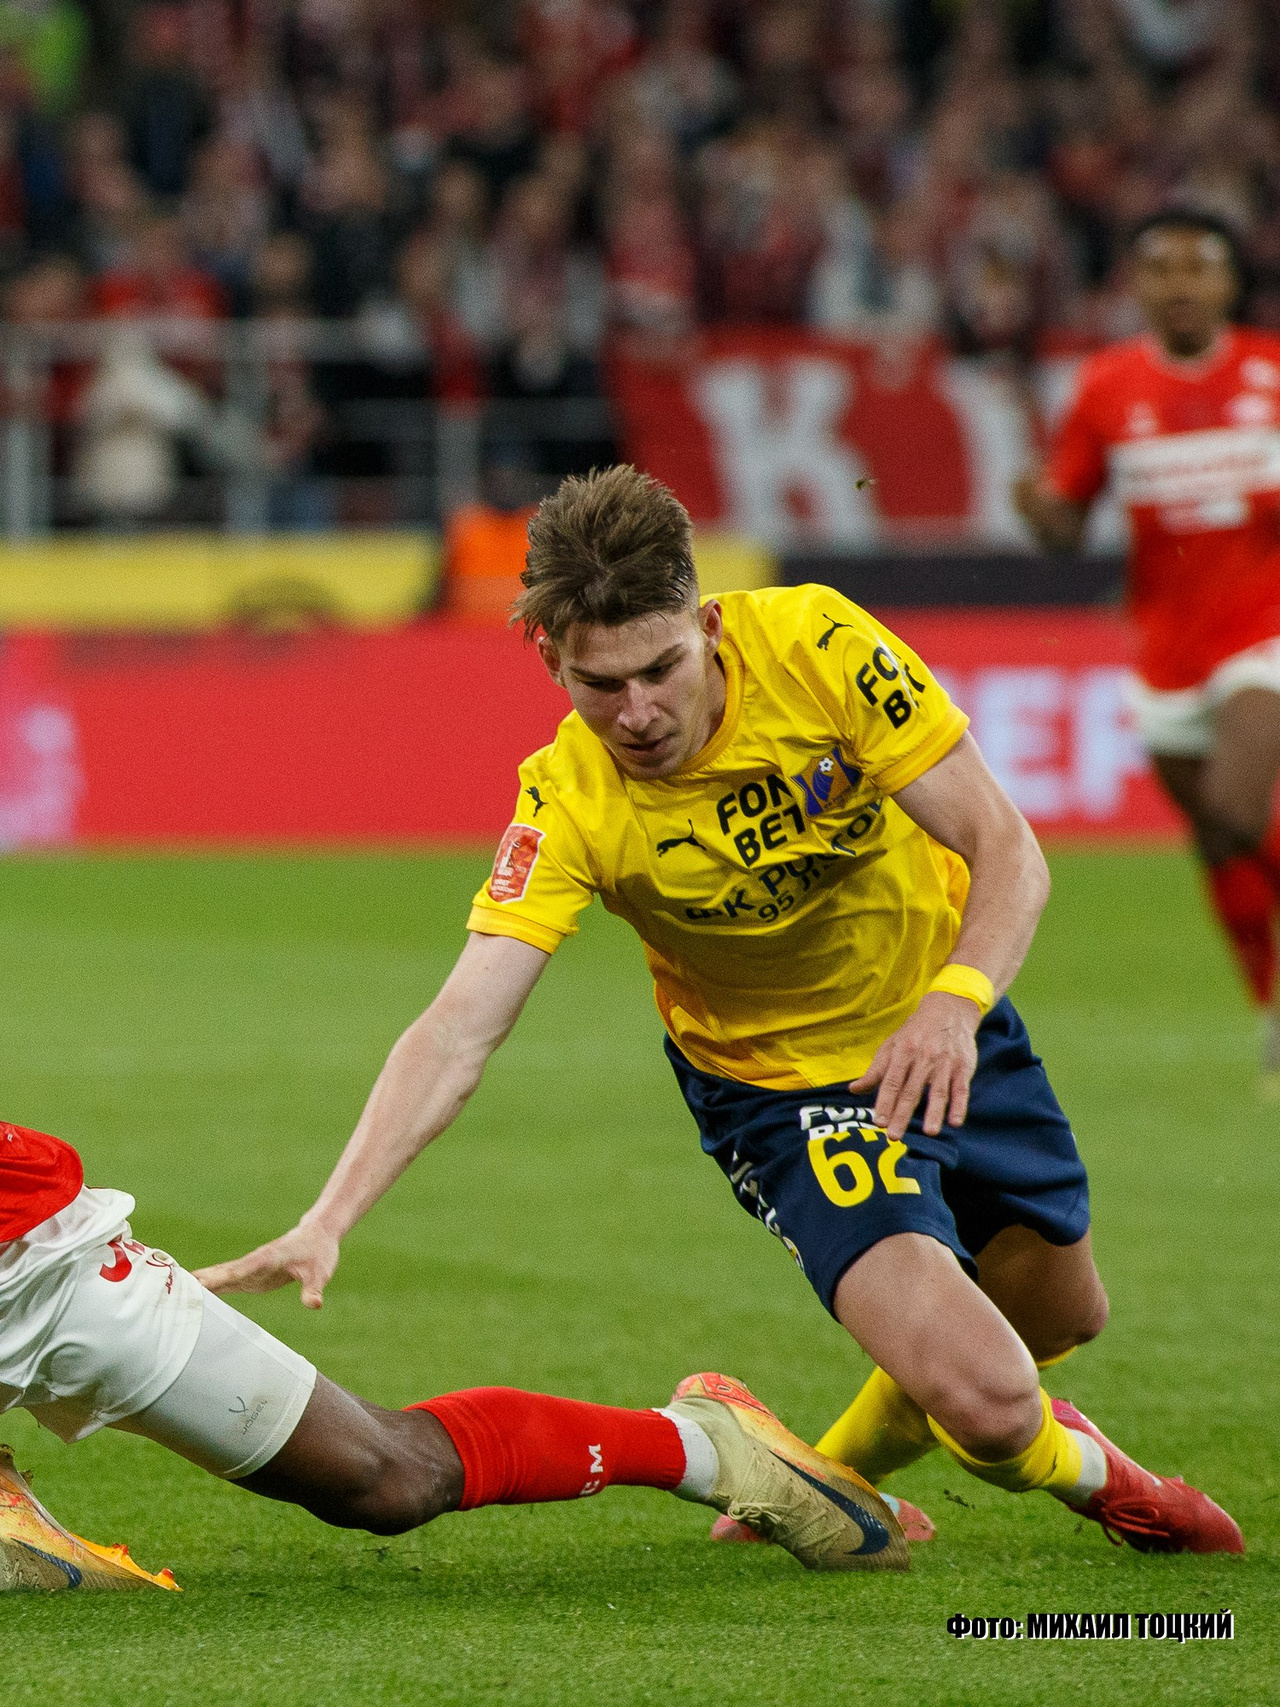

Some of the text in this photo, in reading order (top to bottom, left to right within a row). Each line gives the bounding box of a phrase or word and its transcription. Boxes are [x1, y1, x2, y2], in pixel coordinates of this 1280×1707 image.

[855, 645, 902, 707] FO
[882, 662, 926, 730] BT
[733, 803, 806, 868] BET
[807, 1128, 922, 1207] 62
